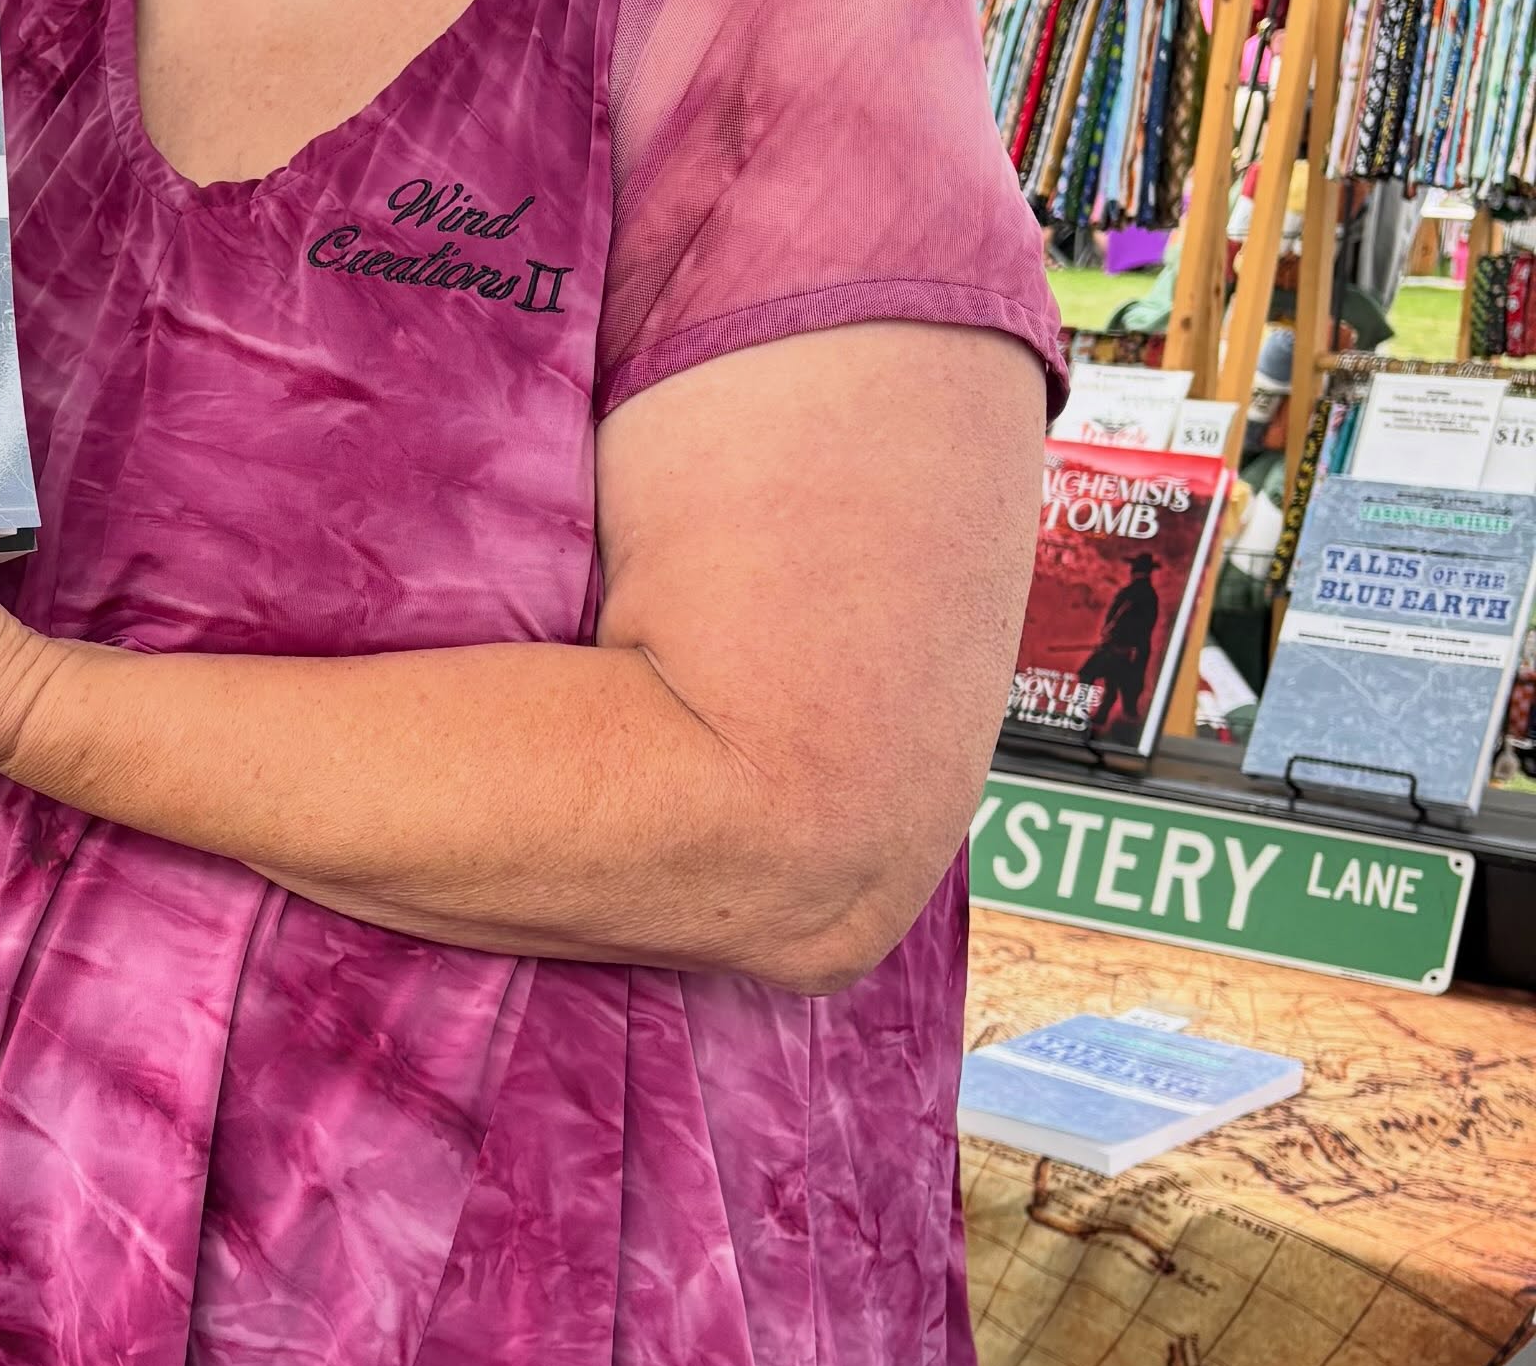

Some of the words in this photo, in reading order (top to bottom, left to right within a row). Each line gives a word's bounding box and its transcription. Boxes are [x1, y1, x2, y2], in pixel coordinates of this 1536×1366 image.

[387, 178, 536, 240] Wind
[307, 224, 522, 301] Creations
[514, 259, 575, 314] II
[1042, 496, 1159, 539] TOMB
[1326, 549, 1421, 579] TALES
[1433, 569, 1459, 585] OF
[1463, 572, 1506, 591] THE
[1318, 579, 1394, 607] BLUE
[1399, 587, 1511, 621] EARTH
[1013, 673, 1057, 701] SON
[1307, 852, 1424, 915] LANE
